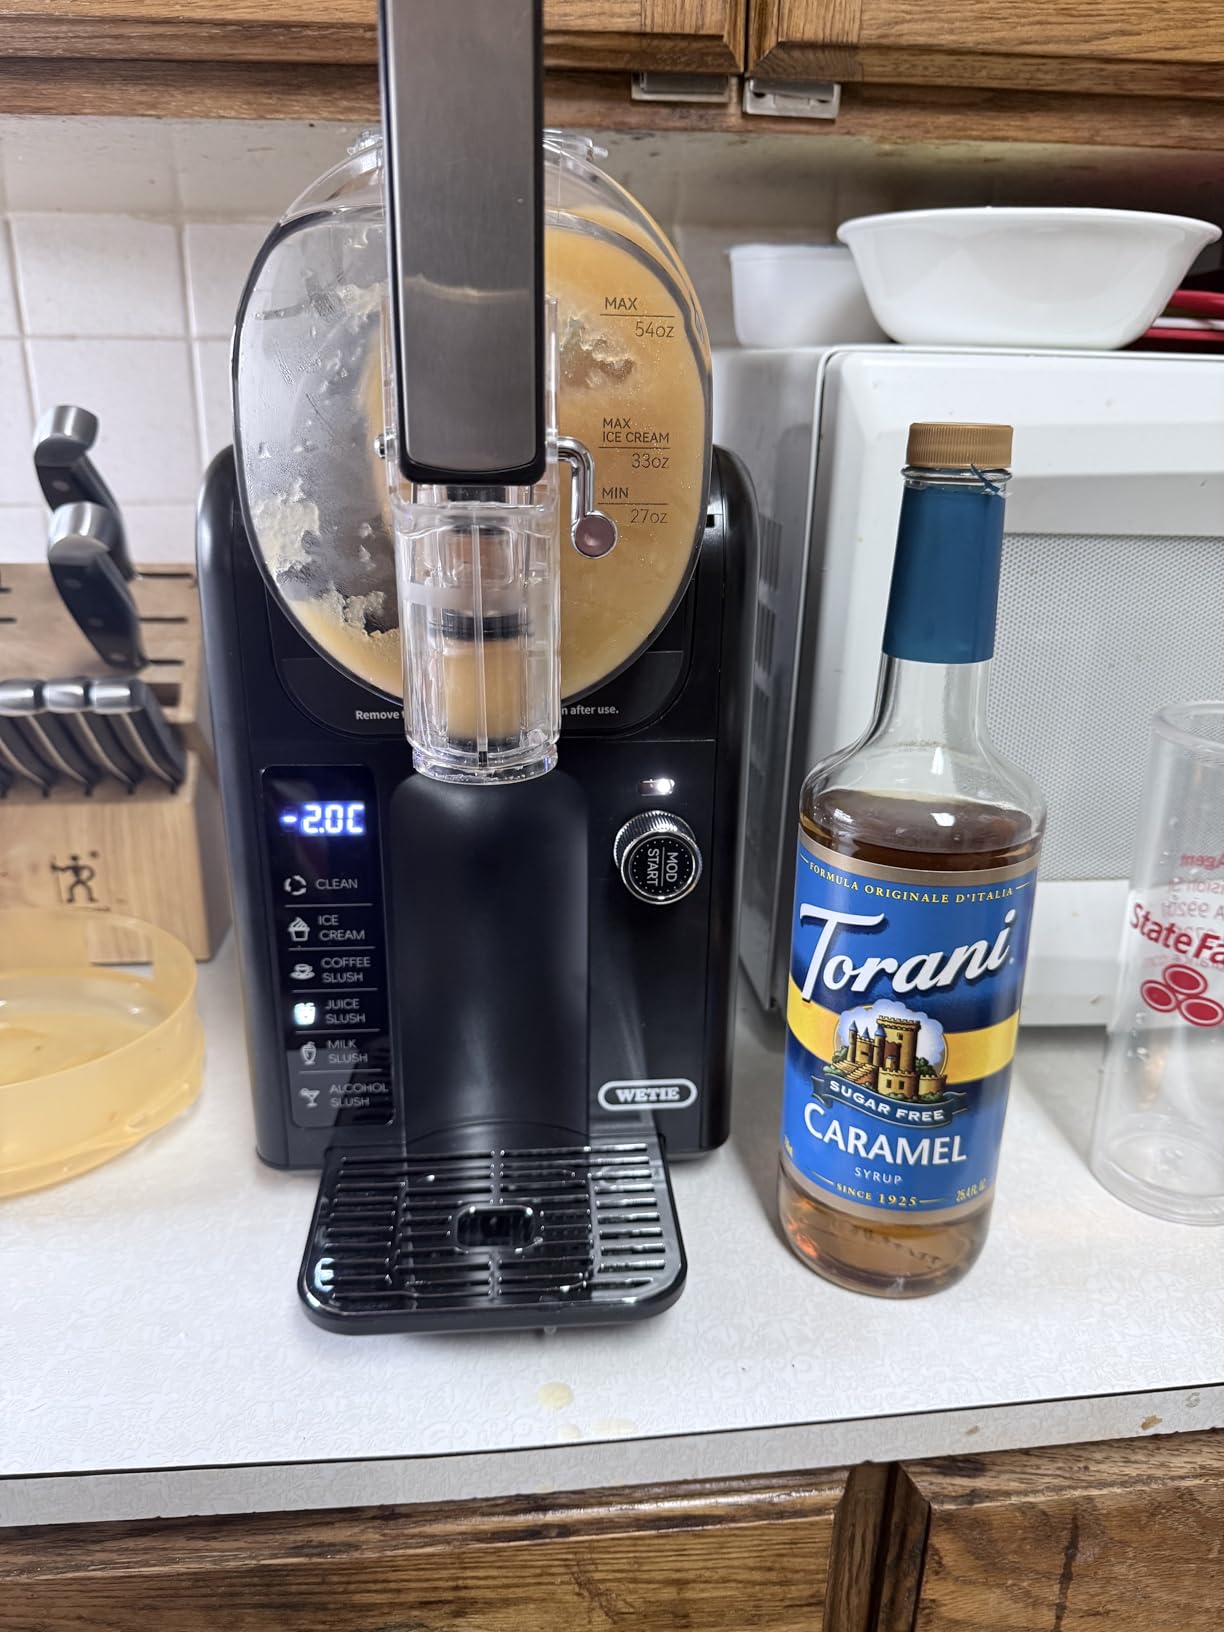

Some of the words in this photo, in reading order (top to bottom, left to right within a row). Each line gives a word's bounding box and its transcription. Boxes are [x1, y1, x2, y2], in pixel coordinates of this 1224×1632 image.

[604, 297, 638, 310] MAX
[635, 321, 675, 338] 54oz
[602, 418, 631, 429] MAX
[602, 432, 621, 443] ICE
[625, 432, 670, 444] CREAM
[631, 453, 670, 469] 33oz
[602, 487, 629, 499] MIN
[630, 509, 668, 524] 27oz
[355, 710, 400, 720] Remove
[570, 705, 596, 715] after
[598, 705, 619, 715] use.
[646, 848, 660, 887] START
[666, 851, 679, 882] MOD
[315, 878, 358, 890] CLEAN
[809, 861, 859, 891] FORMULA
[864, 884, 949, 903] ORIGINALE
[956, 887, 1013, 903] D'ITALIA
[318, 914, 339, 925] ICE
[319, 930, 365, 941] CREAM
[800, 902, 1017, 1001] Torani
[320, 957, 371, 968] COFFEE
[321, 972, 363, 983] SLUSH
[325, 999, 360, 1010] JUICE
[325, 1013, 366, 1024] SLUSH
[327, 1039, 356, 1050] MILK
[328, 1053, 368, 1064] SLUSH
[329, 1082, 389, 1093] ALCOHOL
[615, 1087, 680, 1103] WETIE
[829, 1080, 892, 1116] SUGAR
[896, 1108, 945, 1122] FREE
[330, 1097, 370, 1108] SLUSH
[803, 1102, 968, 1166] CARAMEL
[854, 1167, 903, 1185] SYRUP
[836, 1182, 872, 1201] SINCE
[879, 1193, 918, 1206] 1925
